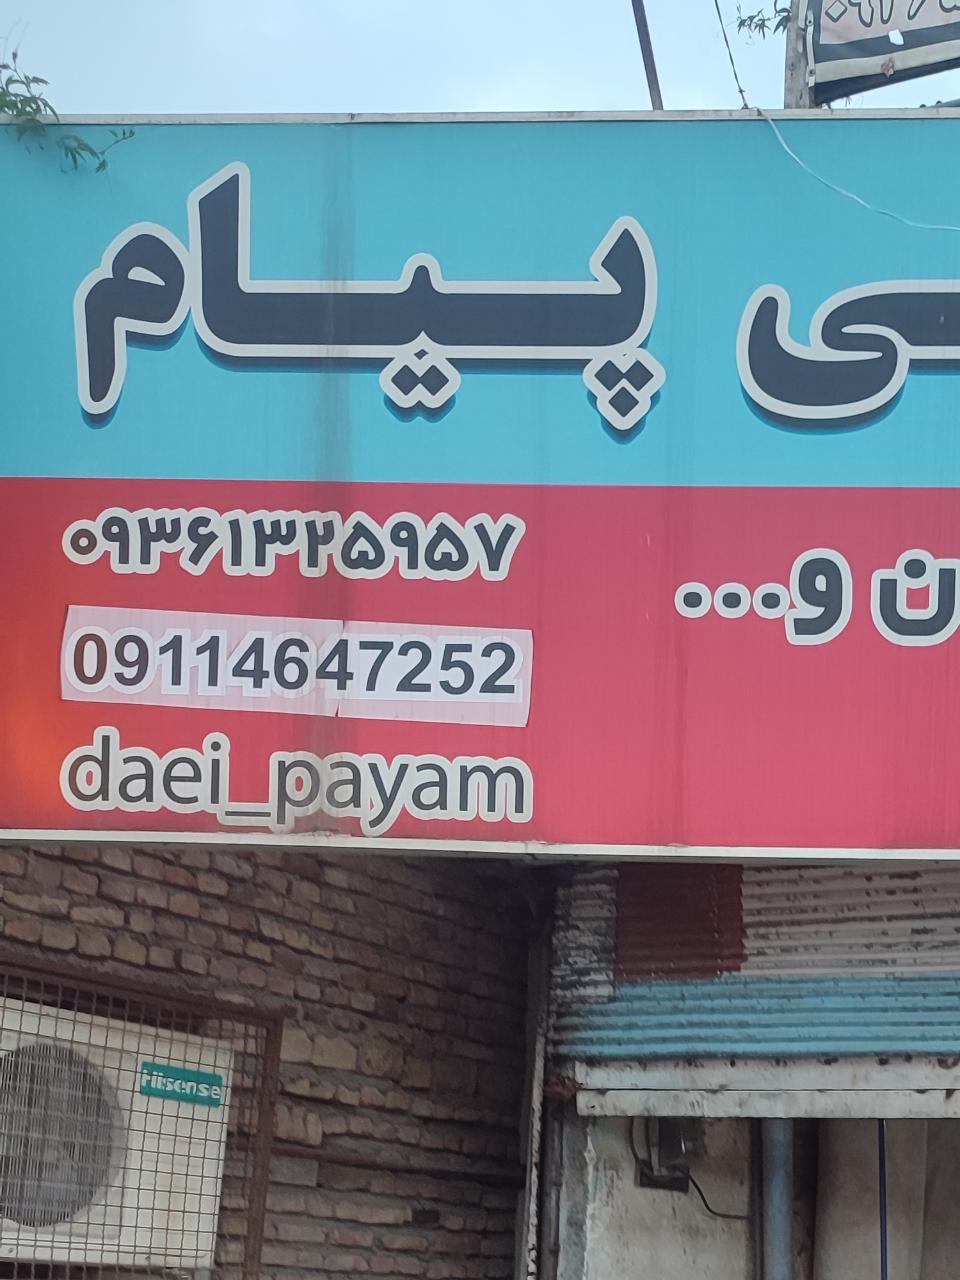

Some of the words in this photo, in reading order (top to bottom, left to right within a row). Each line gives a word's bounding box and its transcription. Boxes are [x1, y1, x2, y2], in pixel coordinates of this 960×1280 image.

[74, 162, 666, 430] پیام
[73, 633, 517, 695] 09114647252
[61, 727, 533, 836] daei_payam
